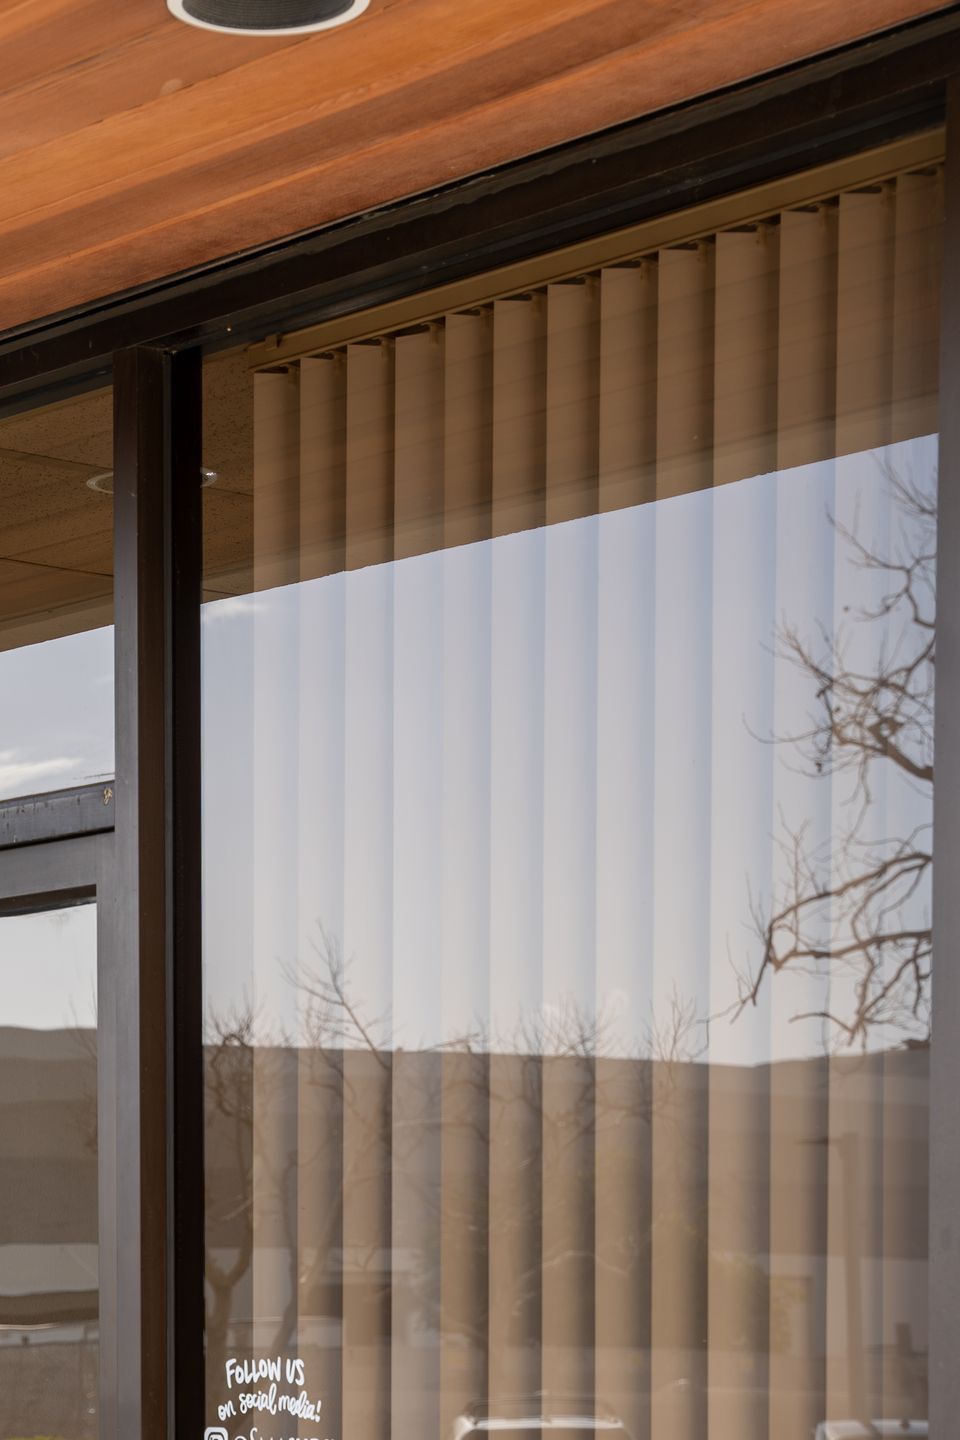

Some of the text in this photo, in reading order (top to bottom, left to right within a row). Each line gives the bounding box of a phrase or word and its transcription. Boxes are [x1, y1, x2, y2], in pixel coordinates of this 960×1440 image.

[225, 1356, 305, 1389] FOLLOW US
[218, 1383, 322, 1423] on social media!
